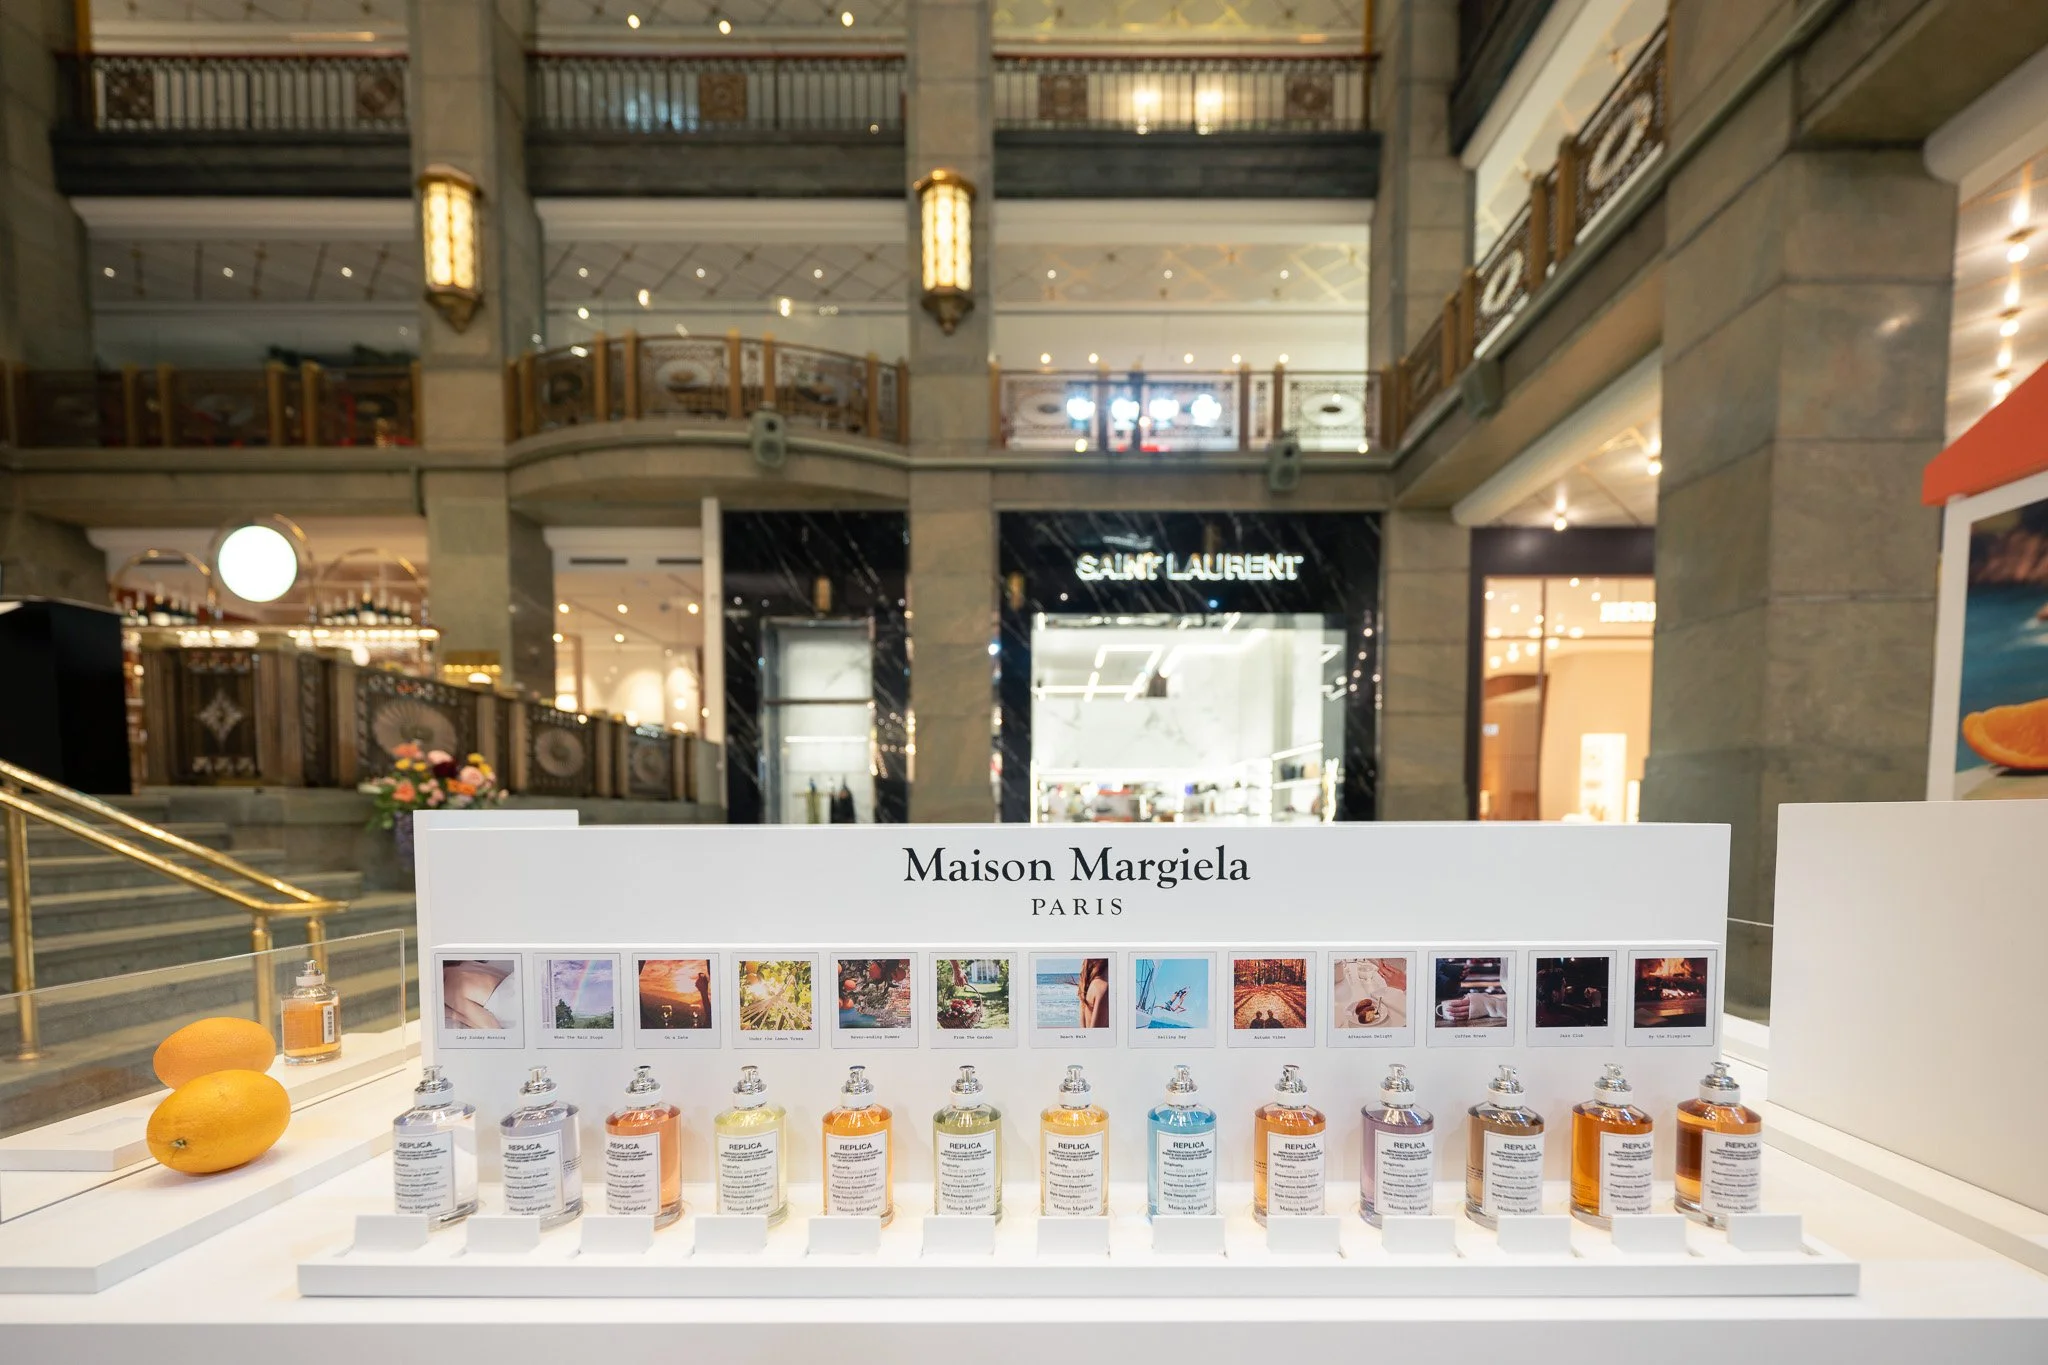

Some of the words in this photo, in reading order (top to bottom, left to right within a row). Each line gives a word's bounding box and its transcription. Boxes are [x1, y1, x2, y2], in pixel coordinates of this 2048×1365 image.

[1075, 552, 1164, 581] SAINT
[1166, 552, 1304, 581] LAURENT
[902, 847, 1055, 882] Maison
[1069, 845, 1250, 889] Margiela
[1031, 898, 1122, 915] PARIS
